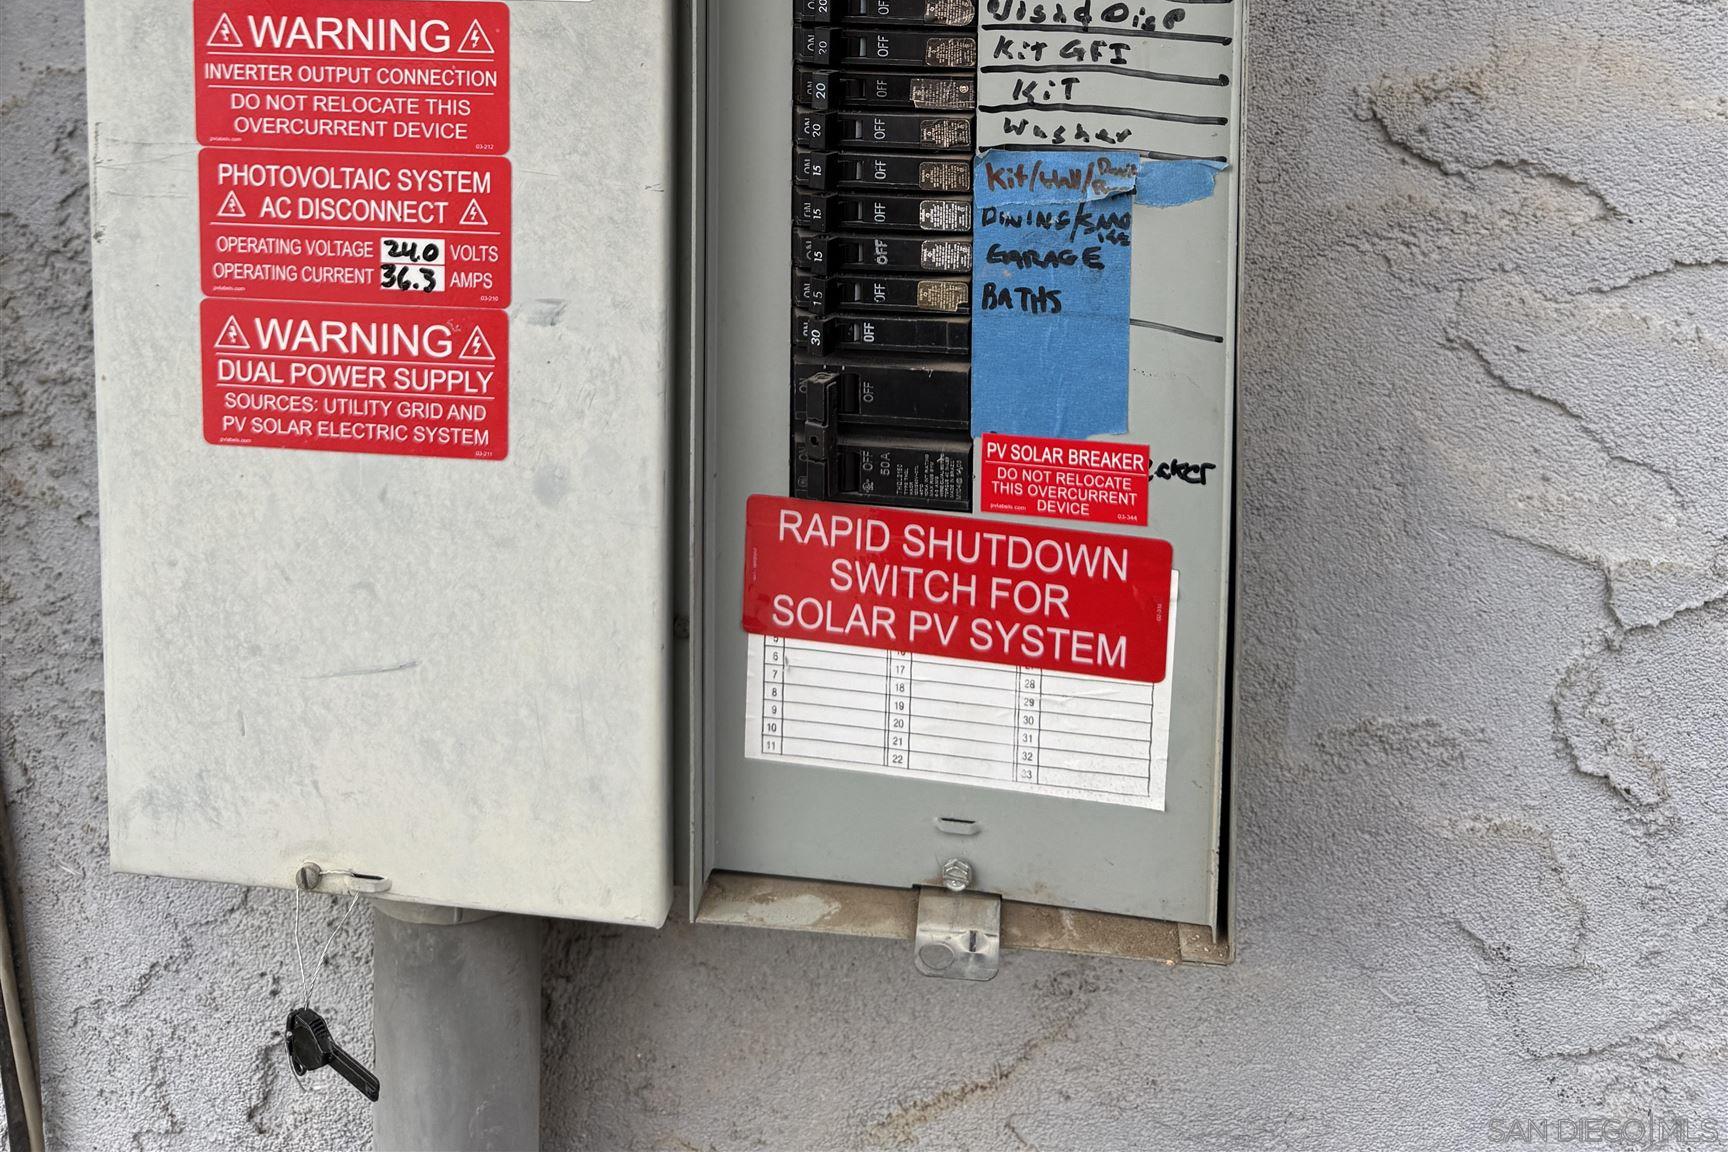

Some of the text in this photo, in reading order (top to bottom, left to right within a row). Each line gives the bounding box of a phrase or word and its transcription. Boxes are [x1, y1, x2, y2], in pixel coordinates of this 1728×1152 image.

[248, 14, 450, 53] WARNING
[204, 63, 497, 88] INVERTER OUTPUT CONNECTION
[230, 93, 471, 116] DO NOT RELOCATE THIS
[815, 82, 826, 100] 20
[233, 116, 468, 140] OVERCURRENT DEVICE
[217, 162, 491, 194] PHOTOVOLTAIC SYSTEM
[260, 196, 449, 224] AC DISCONNECT
[216, 235, 498, 262] OPERATING VOLTAGE VOLTS
[986, 243, 1105, 271] GARAGE
[213, 262, 297, 282] OPERATING
[301, 265, 374, 284] CURRENT
[450, 271, 492, 289] AMPS
[253, 317, 452, 358] WARNING
[217, 359, 494, 394] DUAL POWER SUPPLY
[224, 392, 486, 421] SOURCES: UTILITY GRID AND
[222, 415, 489, 445] PV SOLAR ELECTRIC SYSTEM
[862, 450, 874, 472] OFF
[880, 452, 891, 476] 50A
[986, 442, 1144, 471] PV SOLAR BREAKER
[997, 467, 1132, 491] DO NOT RELOCATE
[991, 480, 1137, 506] THIS OVERCURRENT
[1037, 499, 1090, 516] DEVICE
[778, 509, 1129, 582] RAPID SHUTDOWN
[830, 558, 1070, 620] SWITCH FOR
[772, 594, 1128, 669] SOLAR PV SYSTEM
[896, 665, 905, 674] 17
[1024, 679, 1035, 689] 28
[893, 718, 904, 729] 20
[1022, 751, 1033, 761] 32
